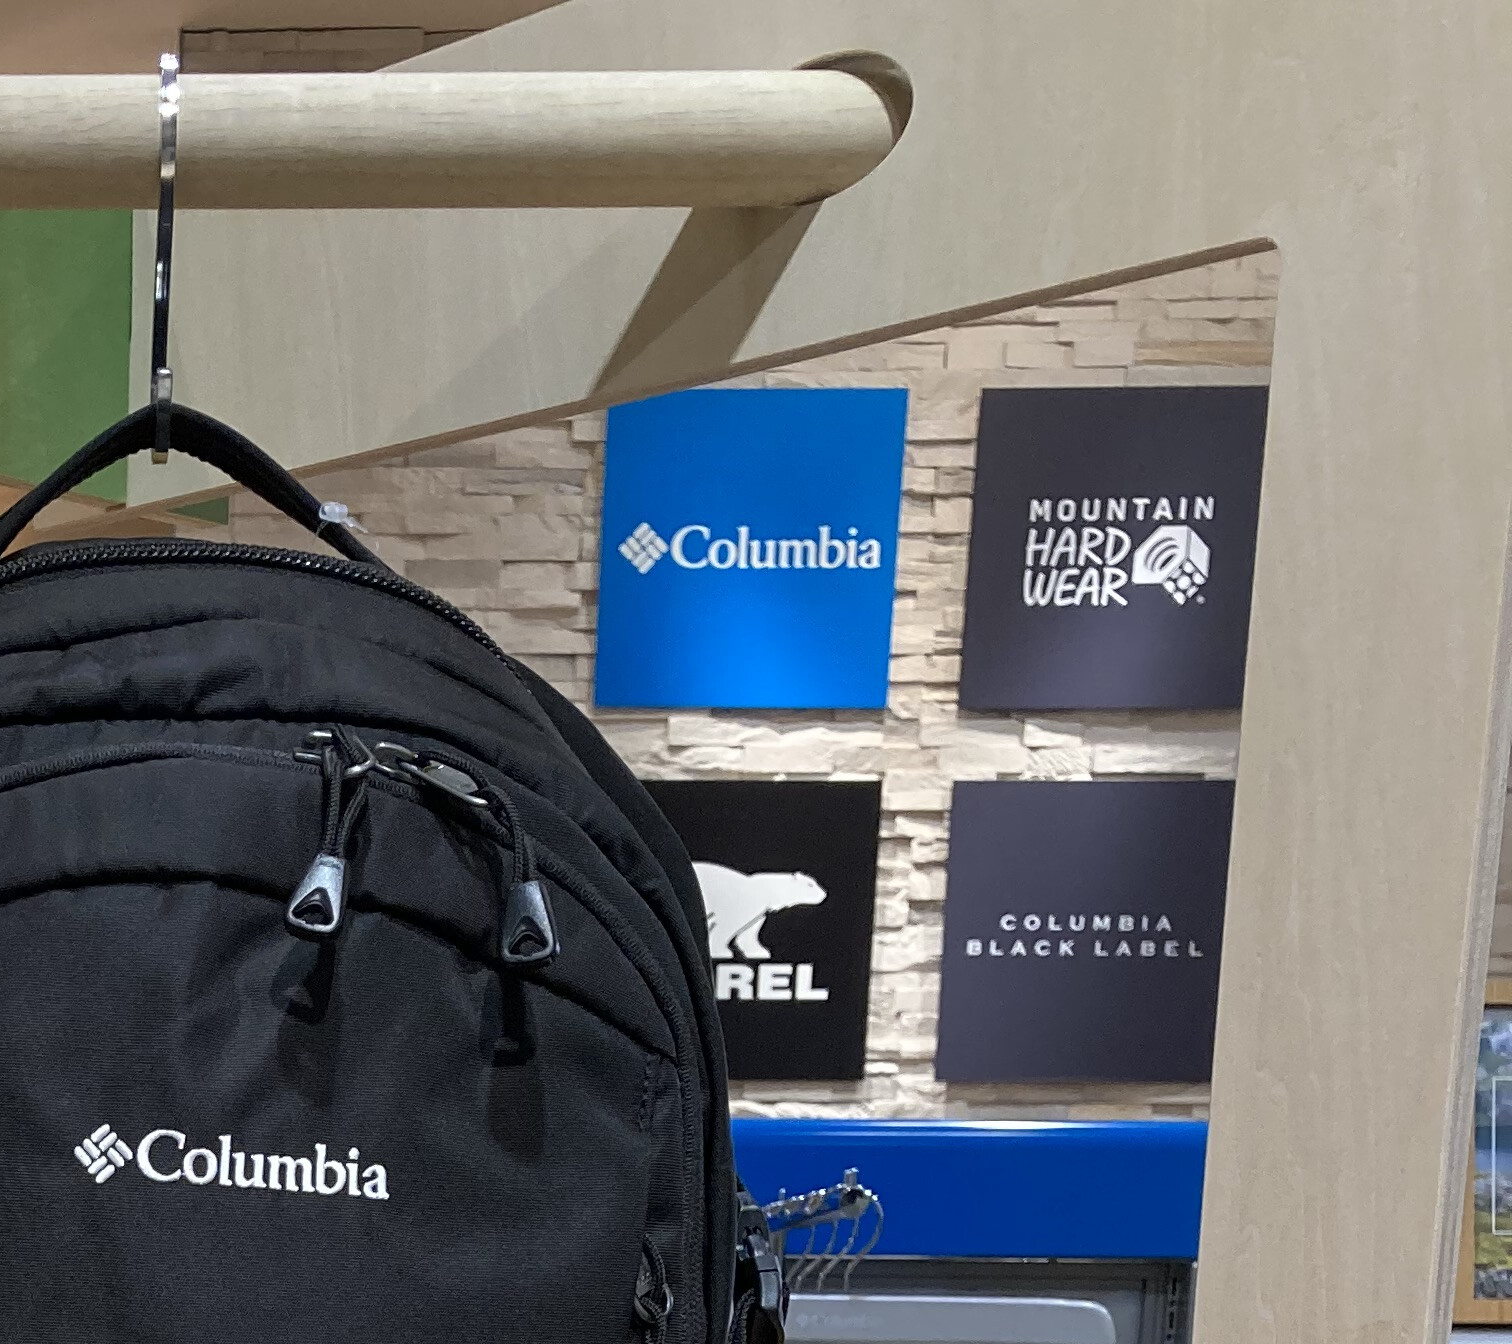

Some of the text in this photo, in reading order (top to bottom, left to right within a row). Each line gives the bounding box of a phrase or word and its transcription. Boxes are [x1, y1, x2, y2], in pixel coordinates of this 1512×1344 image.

[1028, 496, 1216, 523] MOUNTAIN
[670, 524, 882, 570] Columbia
[1024, 525, 1133, 567] HARD
[1022, 566, 1129, 607] WEAR
[999, 913, 1172, 932] COLUMBIA
[965, 938, 1203, 957] BLACK LABEL
[715, 963, 829, 1001] REL
[136, 1129, 390, 1201] Columbia
